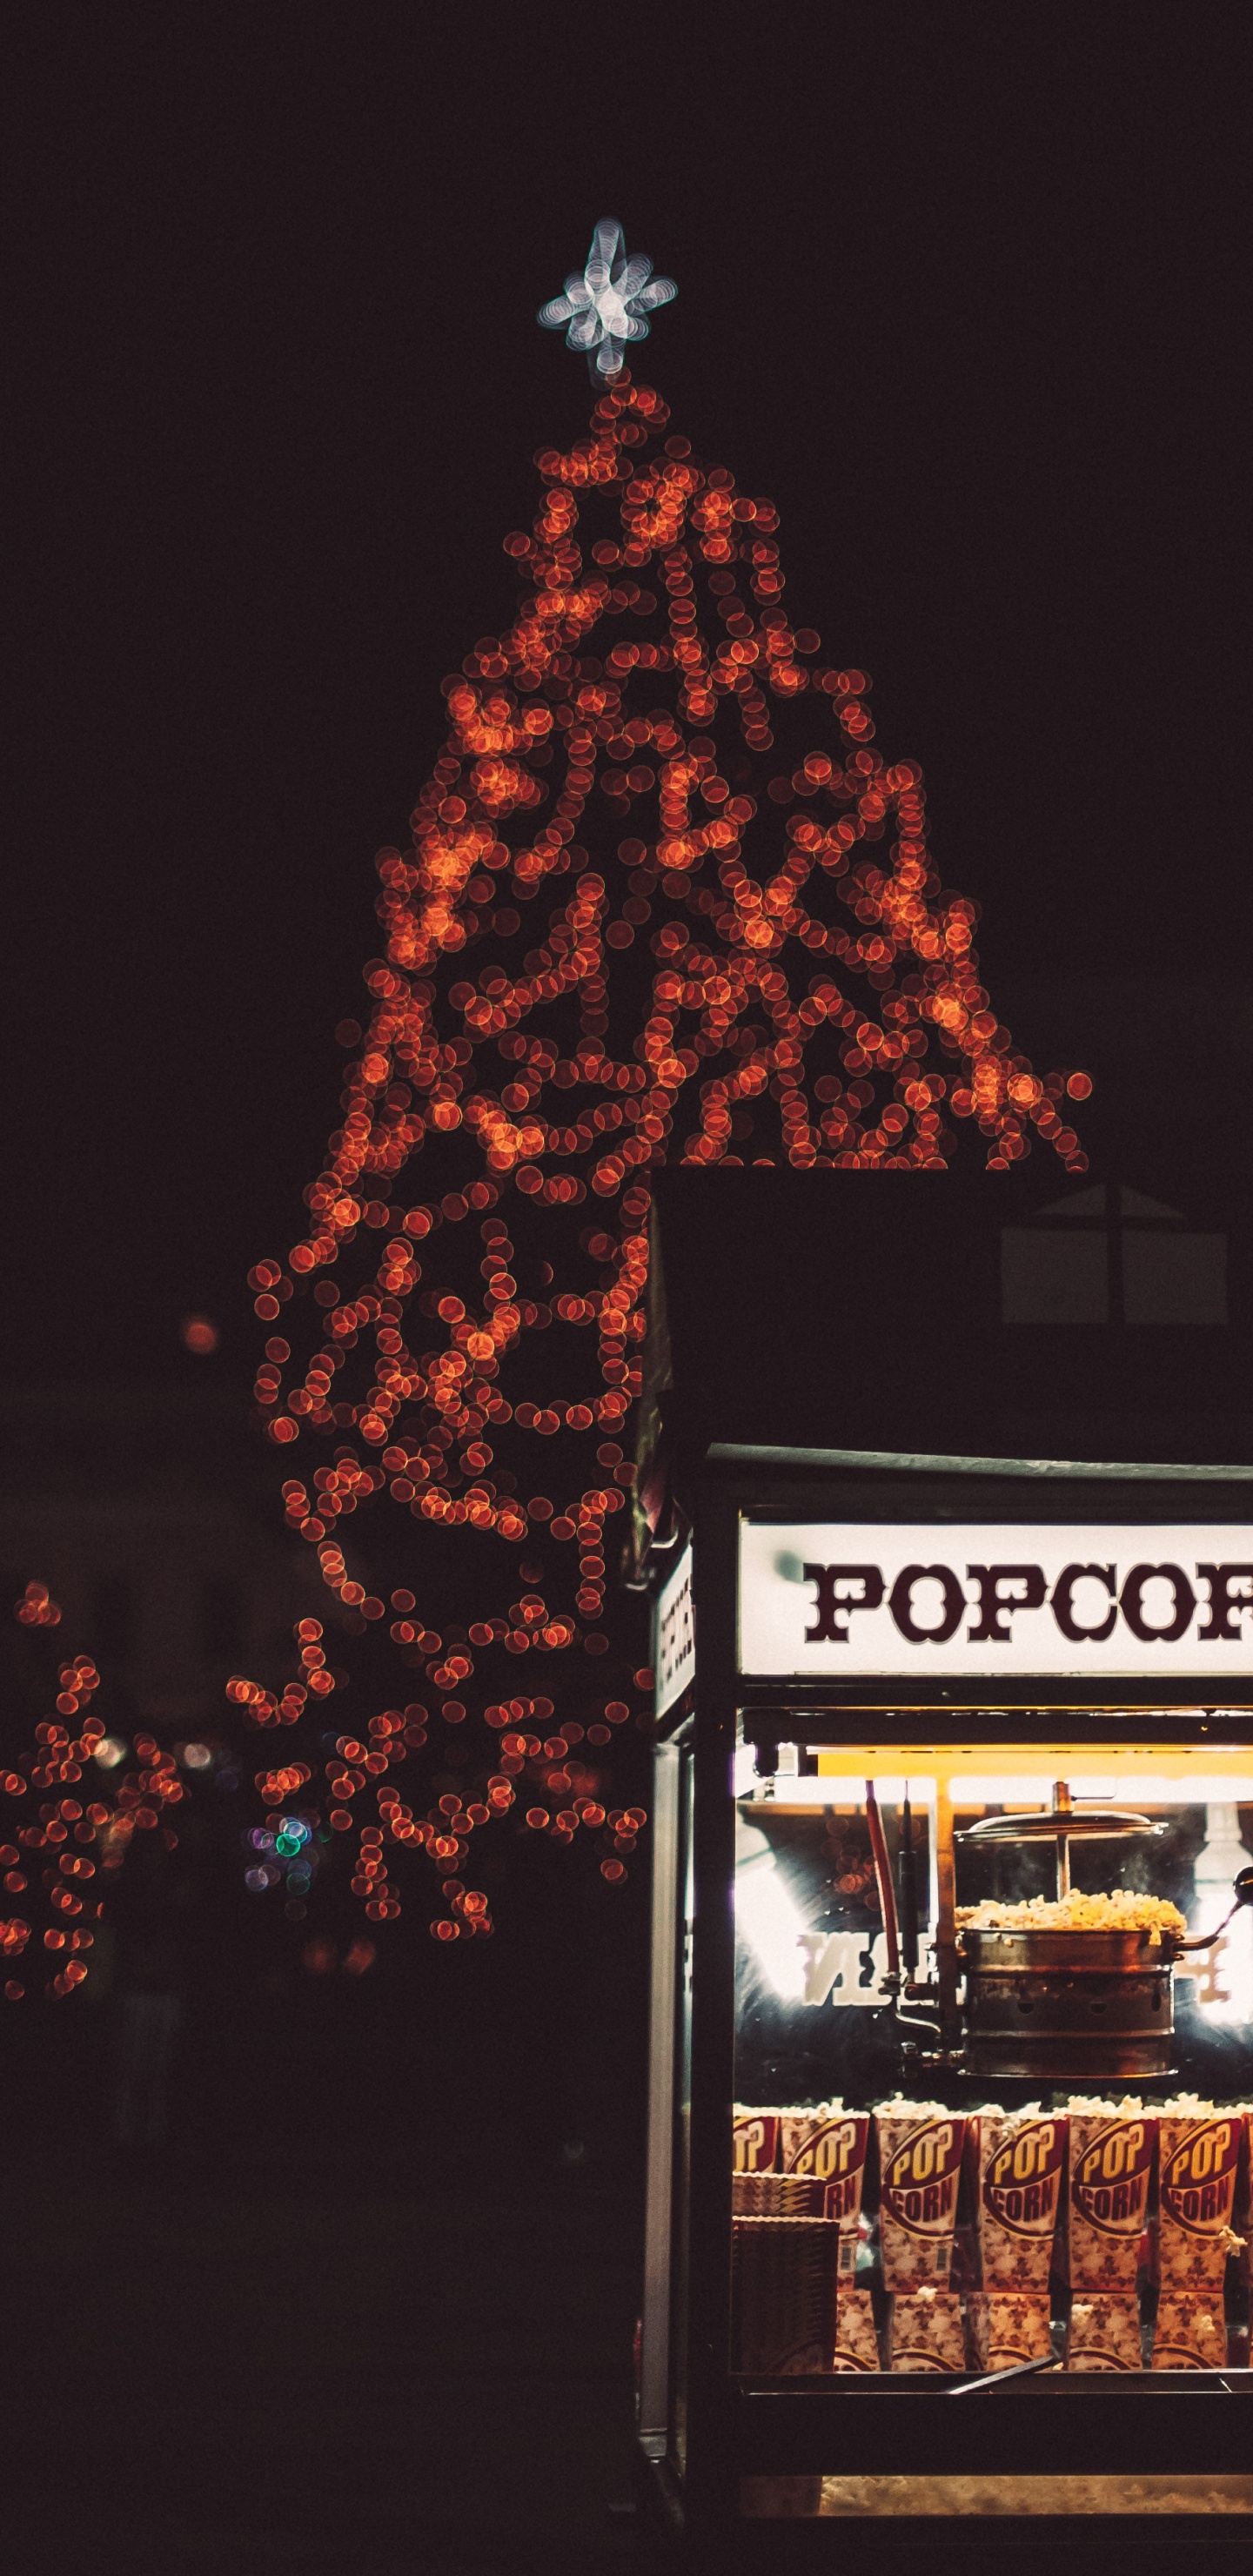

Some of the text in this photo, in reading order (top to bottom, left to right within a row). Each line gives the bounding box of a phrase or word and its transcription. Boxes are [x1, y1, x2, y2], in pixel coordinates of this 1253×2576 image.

[733, 2121, 765, 2172] OP
[796, 2122, 855, 2178] POP
[893, 2123, 953, 2186] POP
[994, 2123, 1055, 2184] POP
[1083, 2123, 1144, 2184] POP
[1172, 2123, 1231, 2185] POP
[893, 2177, 952, 2223] CORN
[992, 2177, 1054, 2222] CORN
[1082, 2177, 1142, 2221] CORN
[1170, 2177, 1229, 2221] CORN
